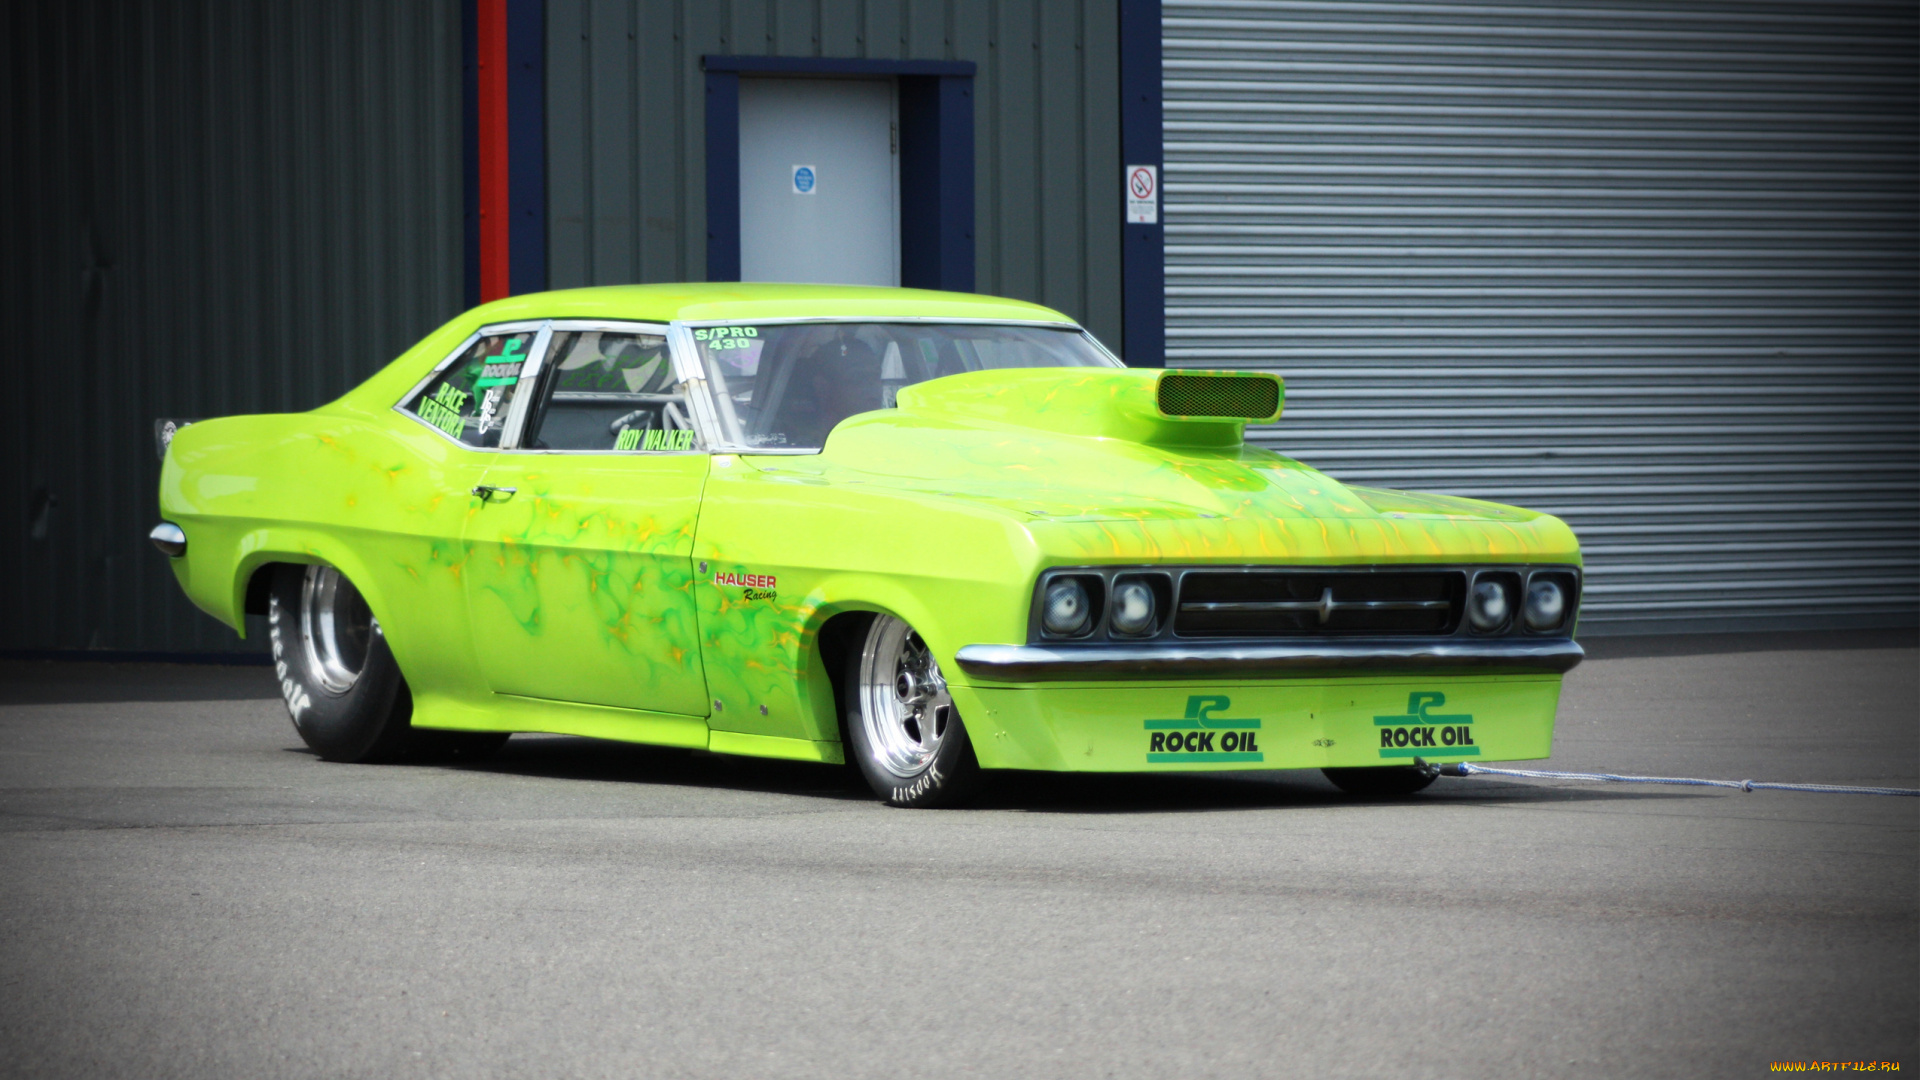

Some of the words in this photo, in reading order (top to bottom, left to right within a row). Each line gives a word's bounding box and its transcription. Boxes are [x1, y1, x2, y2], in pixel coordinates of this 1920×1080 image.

[694, 327, 758, 341] S/PRO
[708, 338, 750, 350] 430
[481, 363, 508, 378] ROCK
[435, 381, 468, 414] RACE
[417, 395, 467, 441] VENTORA
[615, 429, 644, 451] ROY
[642, 429, 695, 451] WALKER
[714, 572, 777, 588] HAUSER
[743, 588, 777, 602] Racing
[1150, 731, 1216, 752] ROCK
[1220, 731, 1259, 752] OIL
[1380, 727, 1438, 748] ROCK
[1440, 725, 1474, 746] OIL
